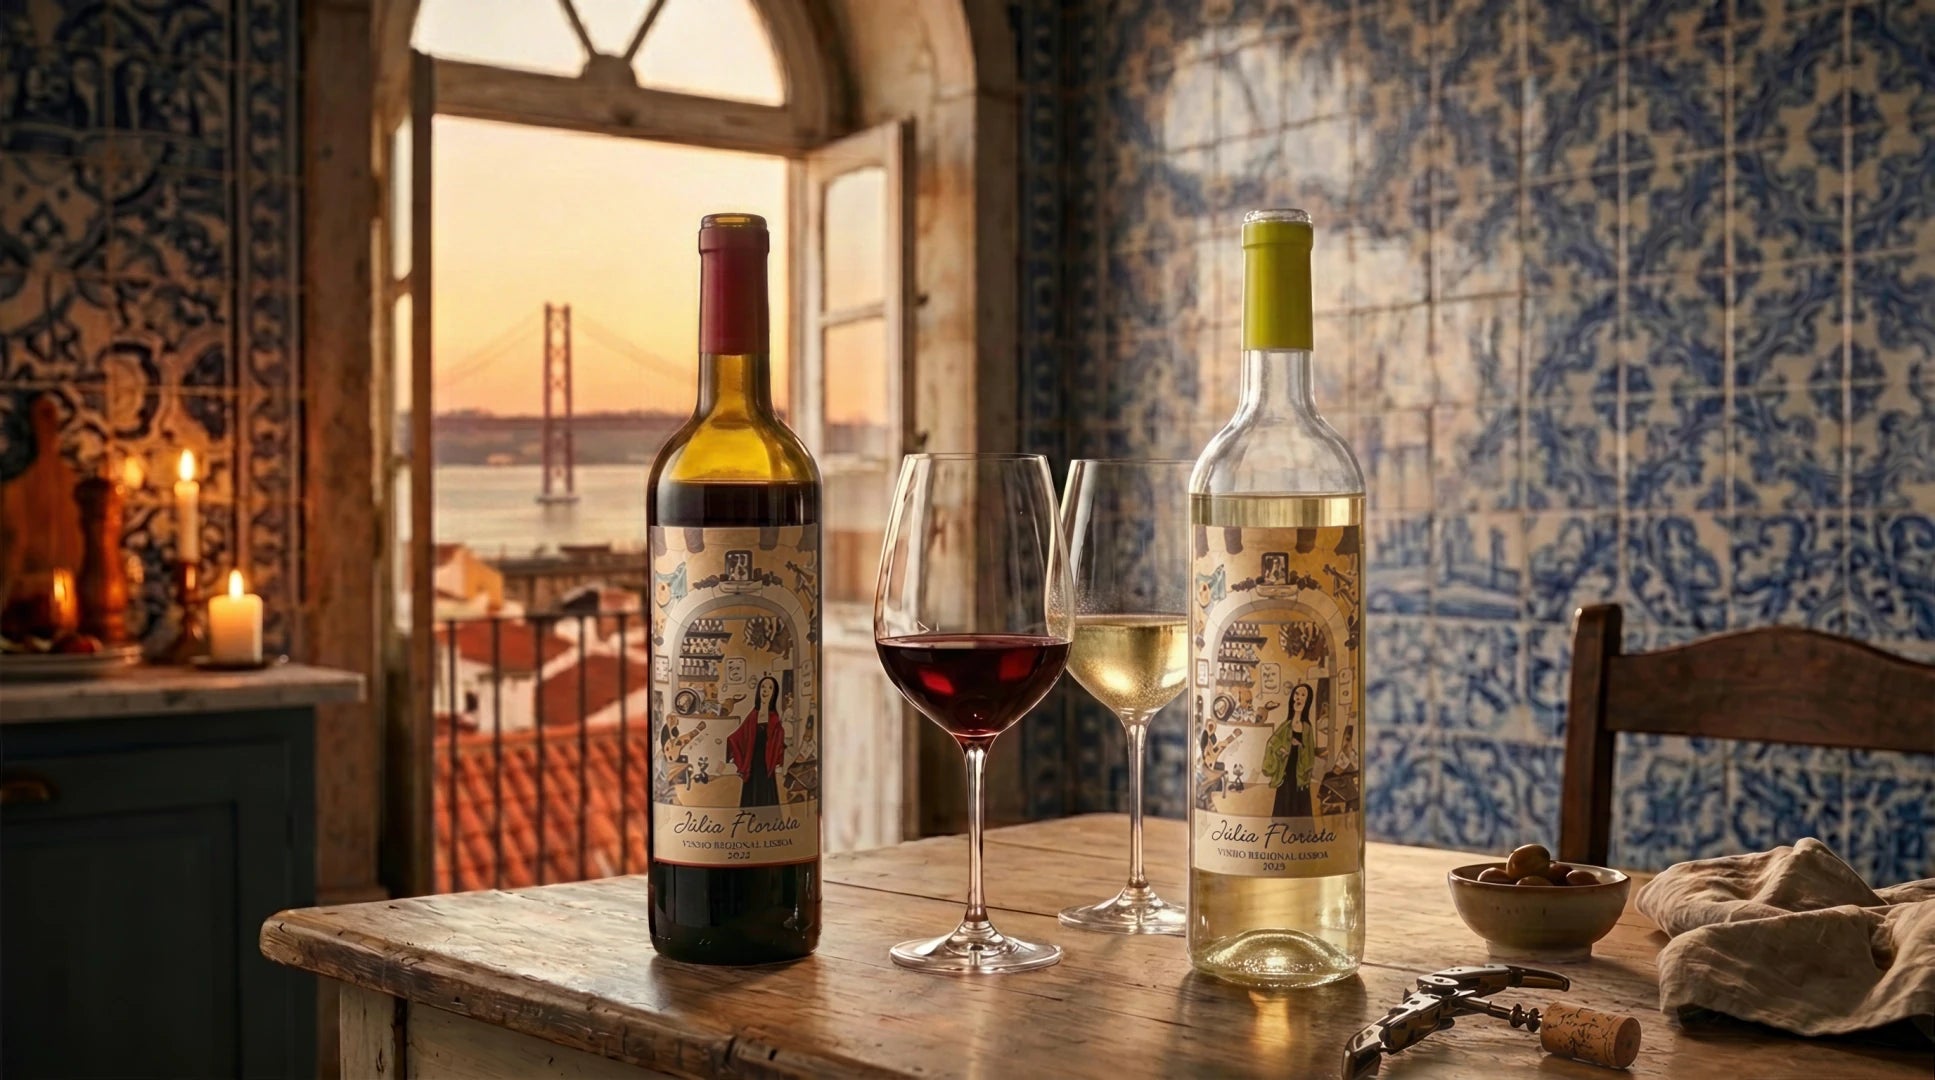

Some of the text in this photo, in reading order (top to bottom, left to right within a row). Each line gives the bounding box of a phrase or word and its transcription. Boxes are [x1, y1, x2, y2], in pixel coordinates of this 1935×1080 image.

[674, 811, 725, 834] Júlia
[1211, 819, 1337, 849] Júlia Florista
[1217, 848, 1246, 859] VINHO
[1248, 850, 1297, 861] REGIONAL
